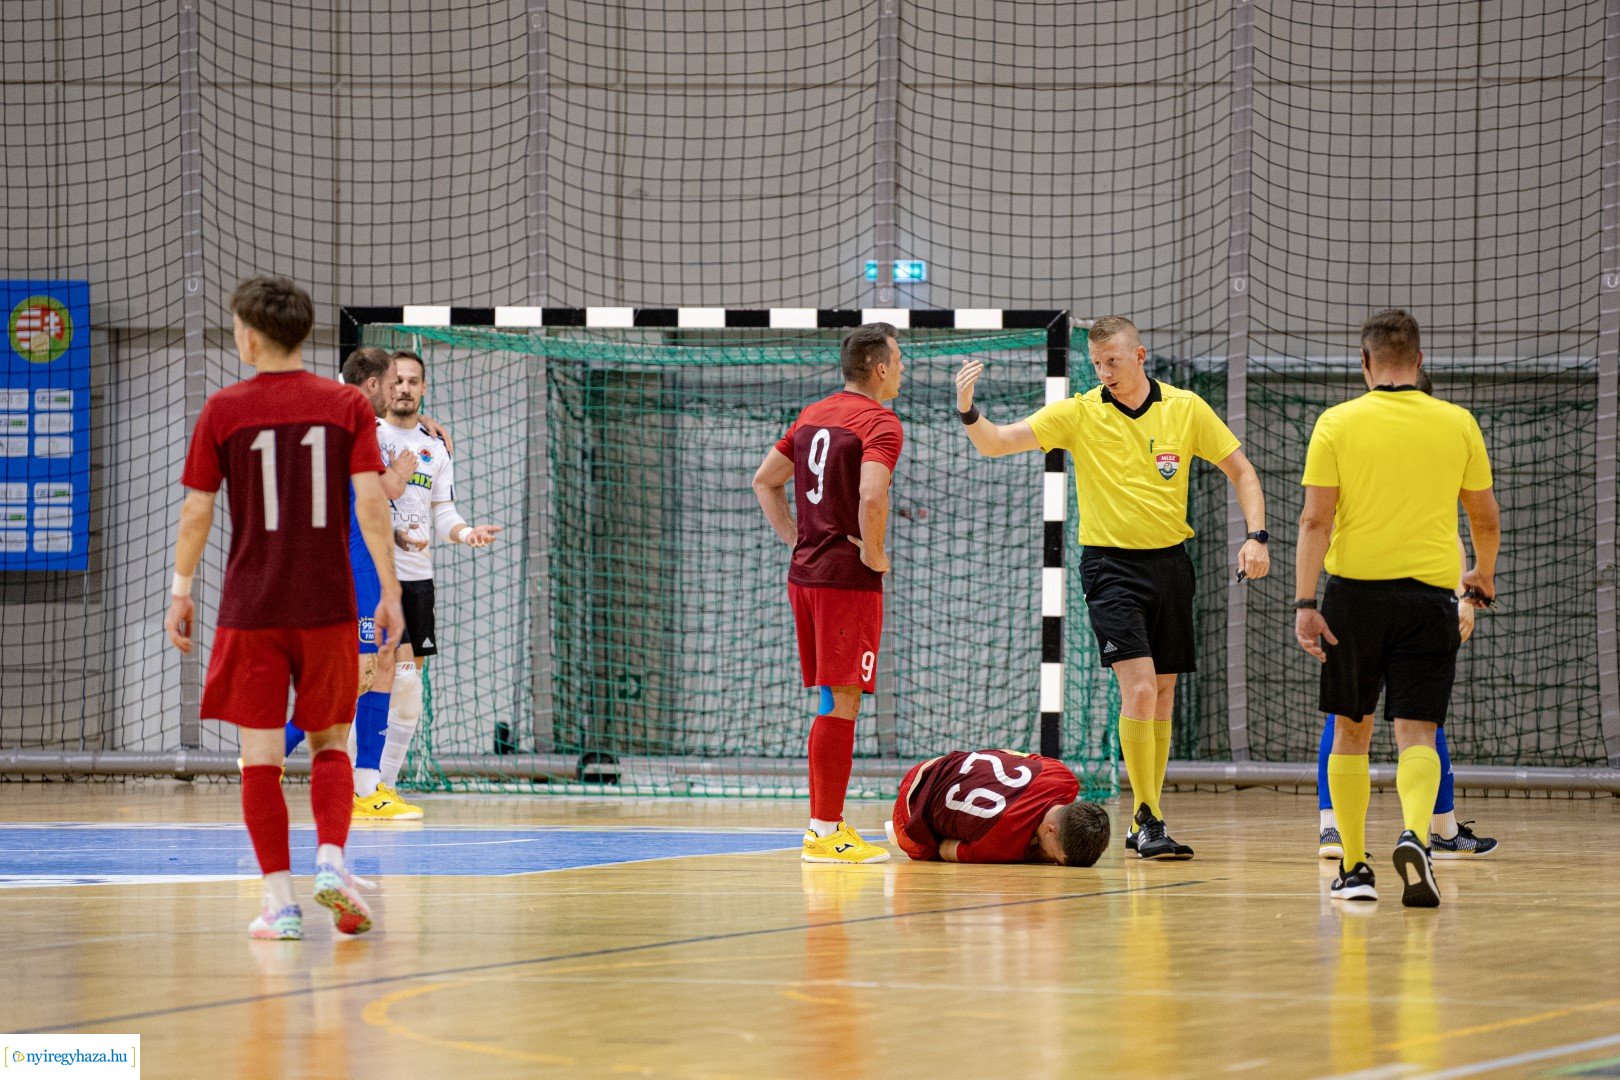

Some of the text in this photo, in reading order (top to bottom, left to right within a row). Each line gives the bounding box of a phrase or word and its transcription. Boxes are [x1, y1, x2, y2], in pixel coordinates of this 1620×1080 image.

[249, 425, 327, 532] 11
[805, 428, 830, 505] 9
[861, 650, 875, 682] 9
[945, 752, 1032, 819] 29
